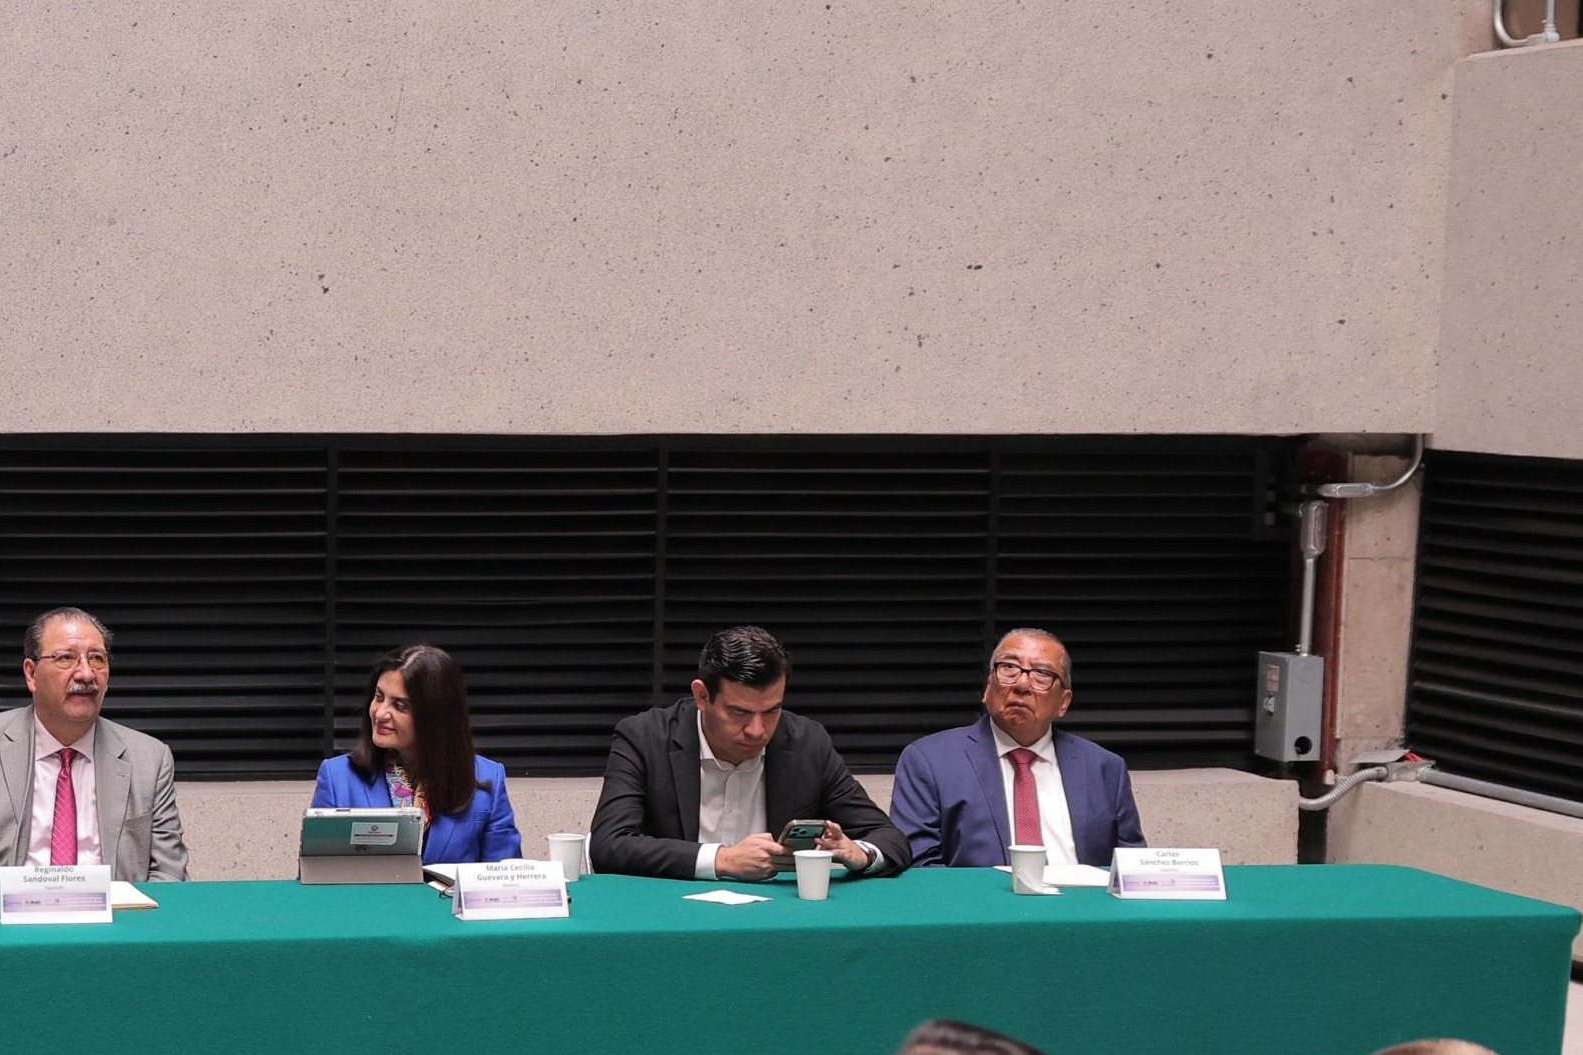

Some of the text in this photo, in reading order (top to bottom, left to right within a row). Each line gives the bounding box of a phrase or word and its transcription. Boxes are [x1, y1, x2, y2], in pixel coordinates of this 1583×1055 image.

[34, 865, 74, 874] Reginaldo
[23, 874, 86, 883] Sandoval Flores
